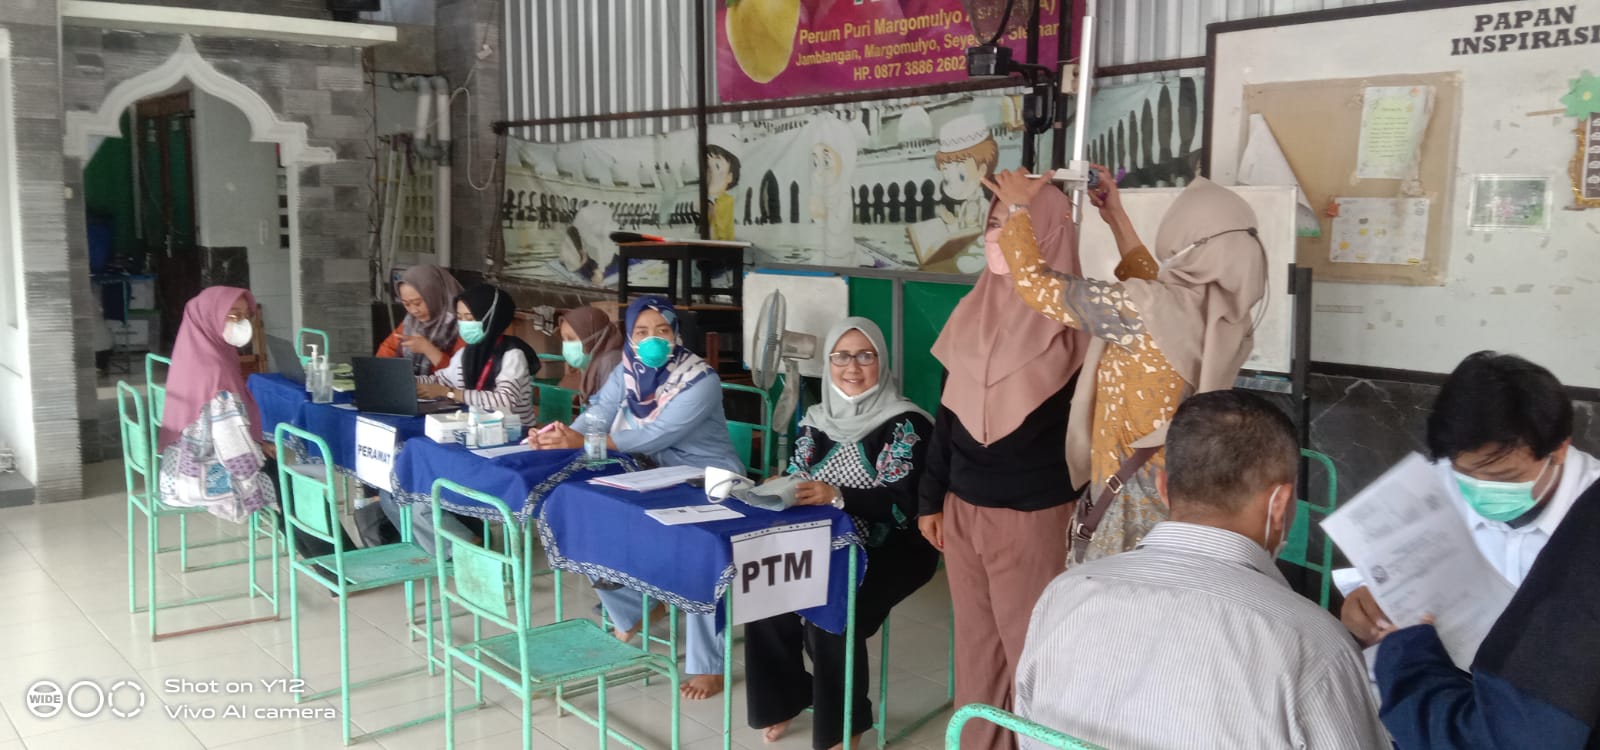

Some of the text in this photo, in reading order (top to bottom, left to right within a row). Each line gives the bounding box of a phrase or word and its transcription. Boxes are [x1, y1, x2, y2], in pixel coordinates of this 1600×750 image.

[799, 28, 841, 46] Perum
[843, 20, 872, 40] Puri
[873, 8, 962, 36] Margomulyo
[1474, 5, 1577, 33] PAPAN
[795, 49, 862, 66] Jamblangan,
[864, 37, 940, 59] Margomulyo,
[1450, 24, 1600, 56] INSPIRASI
[853, 55, 967, 81] HP. 0877 3886 2602
[358, 443, 391, 465] PERAWAT
[742, 549, 813, 594] PTM
